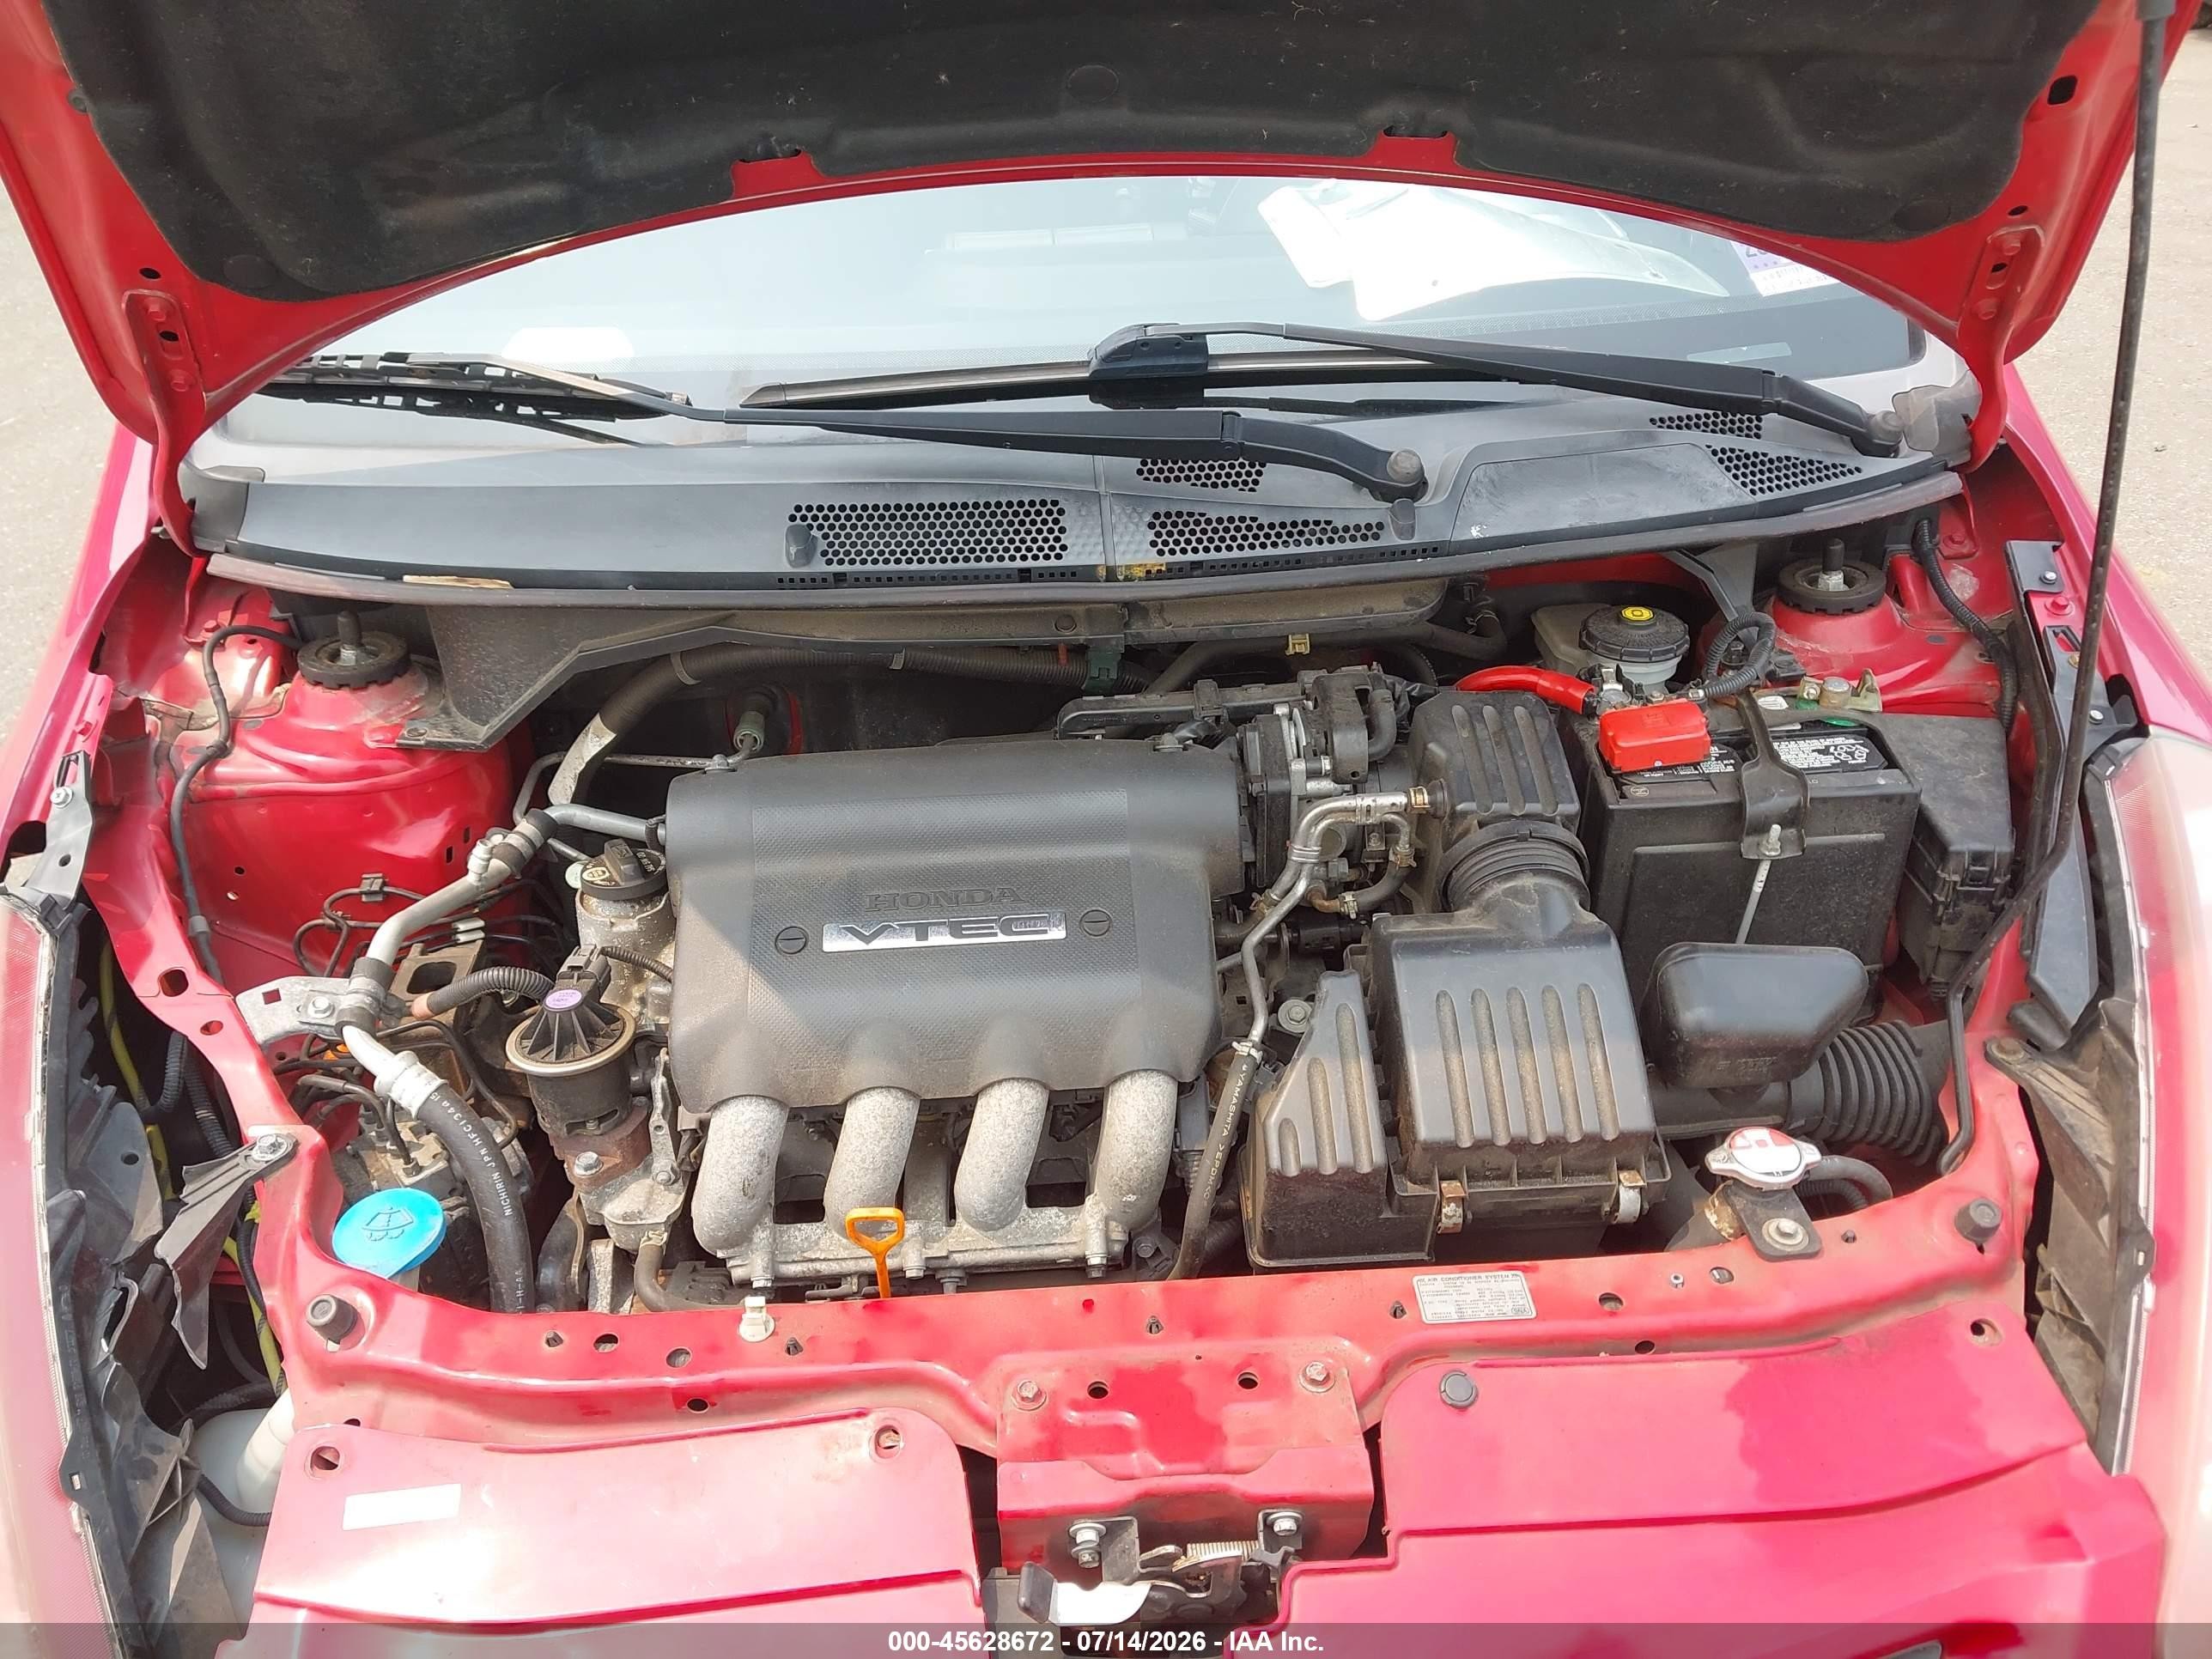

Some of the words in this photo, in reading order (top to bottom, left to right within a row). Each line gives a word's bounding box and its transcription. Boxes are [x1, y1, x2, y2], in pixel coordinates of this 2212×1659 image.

[865, 887, 1030, 912] HONDA
[839, 914, 1049, 945] VTEC
[1222, 1072, 1246, 1137] YAMASHITA
[480, 1146, 495, 1168] JPN
[491, 1171, 514, 1217] NICHIRIN
